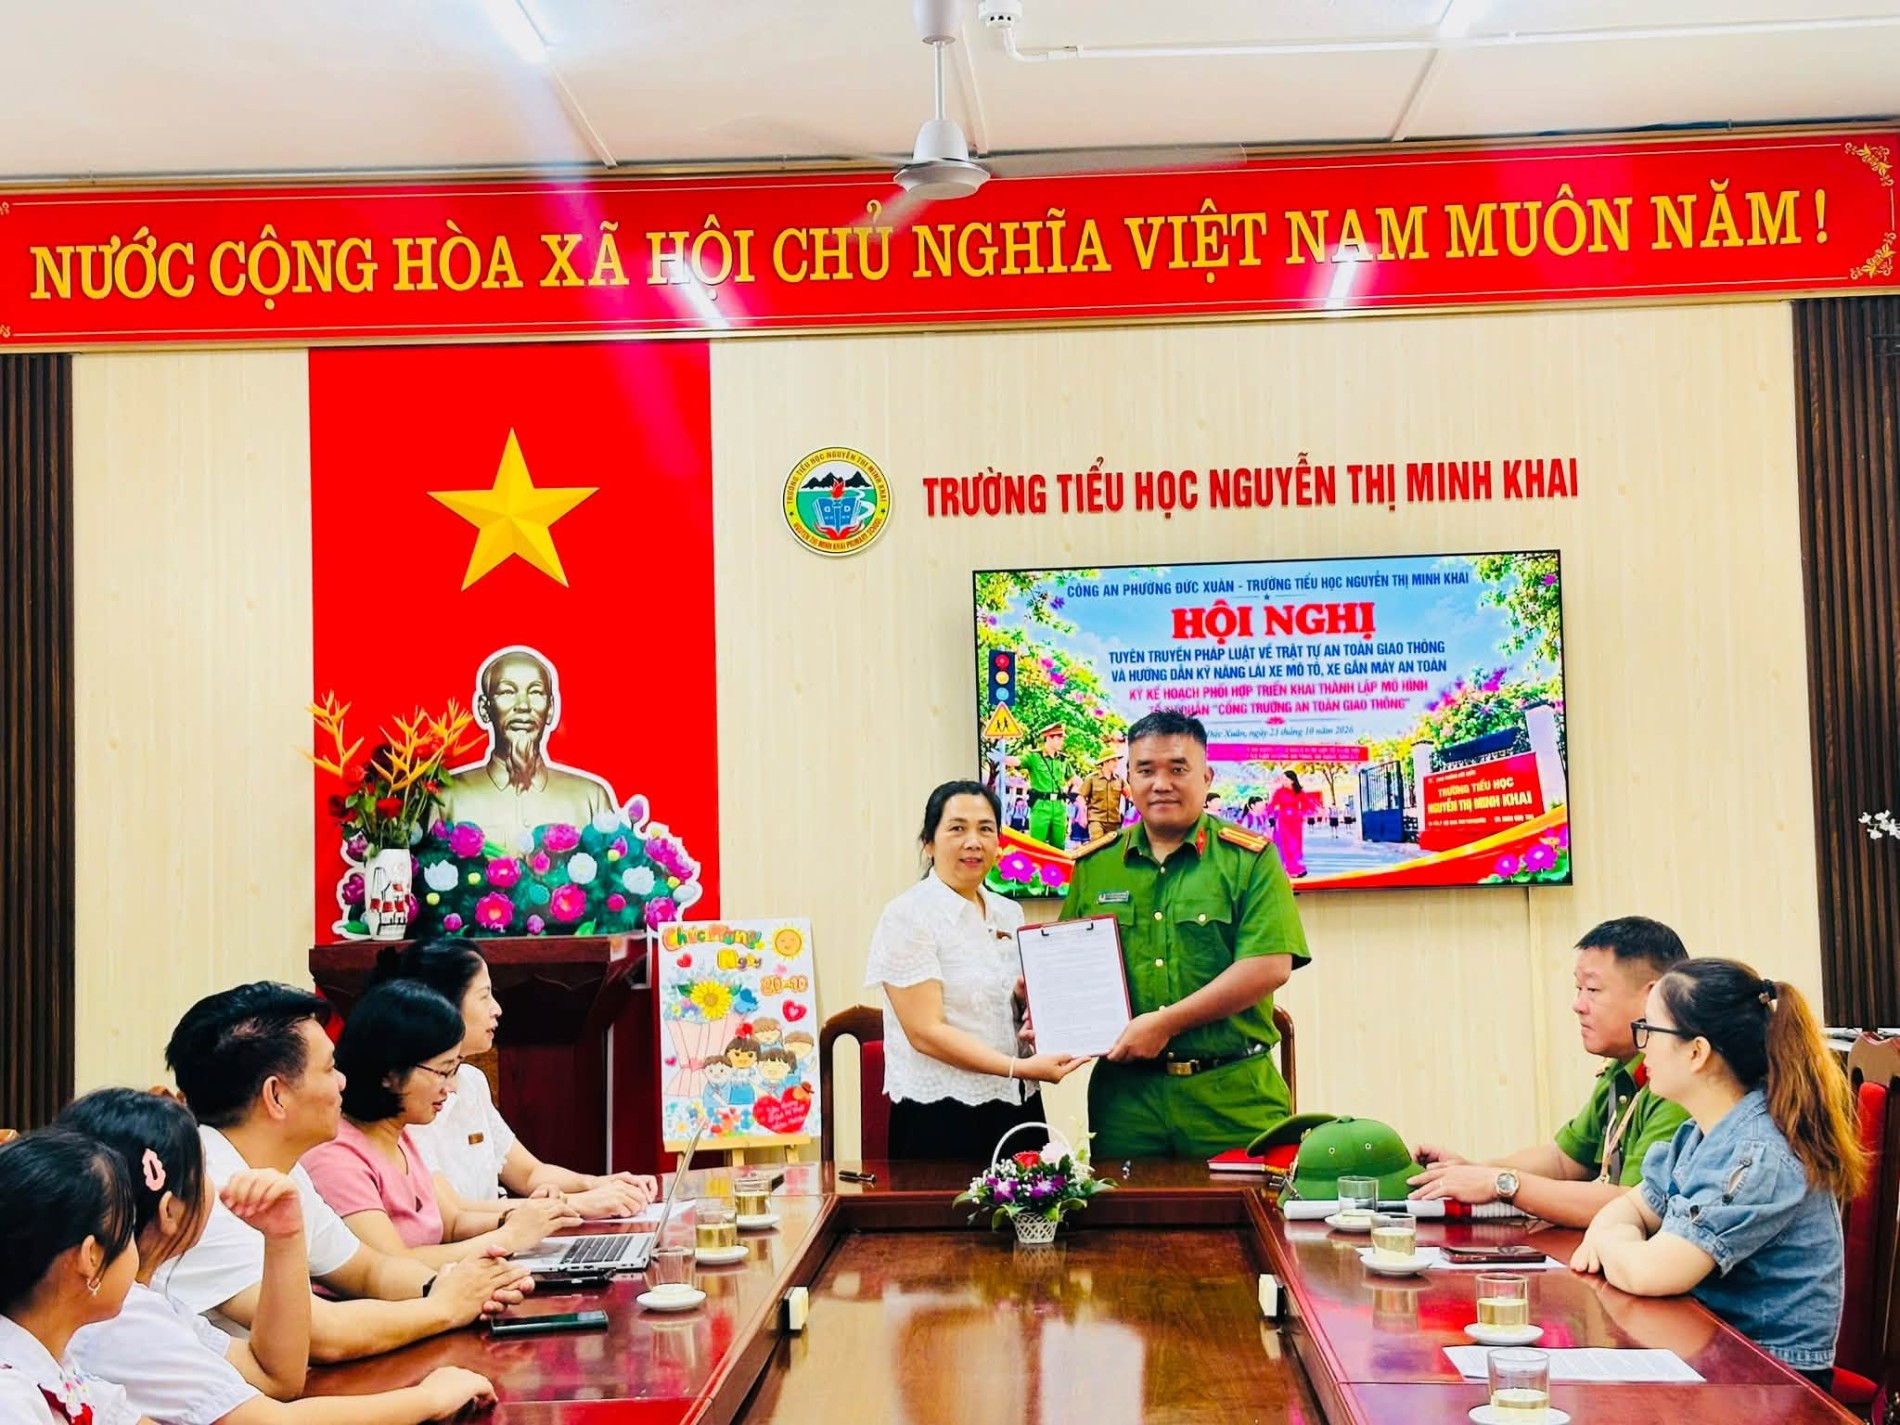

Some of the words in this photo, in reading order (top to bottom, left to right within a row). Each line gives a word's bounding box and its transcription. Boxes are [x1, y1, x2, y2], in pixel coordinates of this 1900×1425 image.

[30, 226, 194, 299] NƯỚC
[210, 224, 377, 310] CỘNG
[393, 219, 523, 291] HÒA
[540, 221, 628, 287] XÃ
[646, 214, 756, 300] HỘI
[773, 200, 893, 283] CHỦ
[913, 209, 1111, 279] NGHĨA
[1125, 198, 1267, 284] VIỆT
[1286, 205, 1428, 265] NAM
[1445, 183, 1632, 257] MUÔN
[923, 466, 1046, 516] TRƯỜNG
[1056, 456, 1123, 513] TIỂU
[1135, 469, 1198, 518] HỌC
[1209, 452, 1336, 508] NGUYỄN
[1347, 464, 1396, 511] THỊ
[1407, 460, 1491, 502] MINH
[1502, 458, 1579, 500] KHAI
[1067, 582, 1099, 598] CÔNG
[1103, 584, 1119, 596] AN
[1123, 580, 1172, 596] PHƯỜNG
[1175, 578, 1199, 594] ĐỨC
[1203, 577, 1234, 593] XUÂN
[1247, 575, 1291, 592] TRƯỜNG
[1294, 572, 1318, 590] TIỂU
[1321, 575, 1342, 591] HỌC
[1346, 570, 1389, 588] NGUYỄN
[1392, 574, 1409, 589] THỊ
[1412, 573, 1441, 586] MINH
[1444, 571, 1469, 585] KHAI
[1171, 598, 1253, 645] HỘI
[1264, 602, 1376, 640] NGHỊ
[1109, 648, 1145, 664] TUYÊN
[1148, 646, 1191, 662] TRUYỀN
[1195, 646, 1225, 661] PHÁP
[1228, 645, 1255, 662] LUẬT
[1258, 643, 1273, 659] VỀ
[1276, 642, 1303, 661] TRẬT
[1306, 643, 1321, 660] TỰ
[1324, 644, 1340, 656] AN
[1343, 640, 1373, 656] TOÀN
[1376, 642, 1403, 654] GIAO
[1407, 640, 1445, 654] THÔNG
[1111, 667, 1126, 682] VÀ
[1170, 664, 1193, 681] DẪN
[1249, 662, 1265, 678] LÁI
[1269, 664, 1282, 677] XE
[1286, 662, 1304, 677] MÔ
[1327, 663, 1340, 676] XE
[1371, 659, 1395, 674] MÁY
[1398, 662, 1414, 673] AN
[1417, 658, 1447, 672] TOÀN
[1290, 683, 1315, 695] KHAI
[1294, 701, 1309, 713] AN
[1343, 700, 1367, 711] GIAO
[1502, 791, 1532, 807] KHAI
